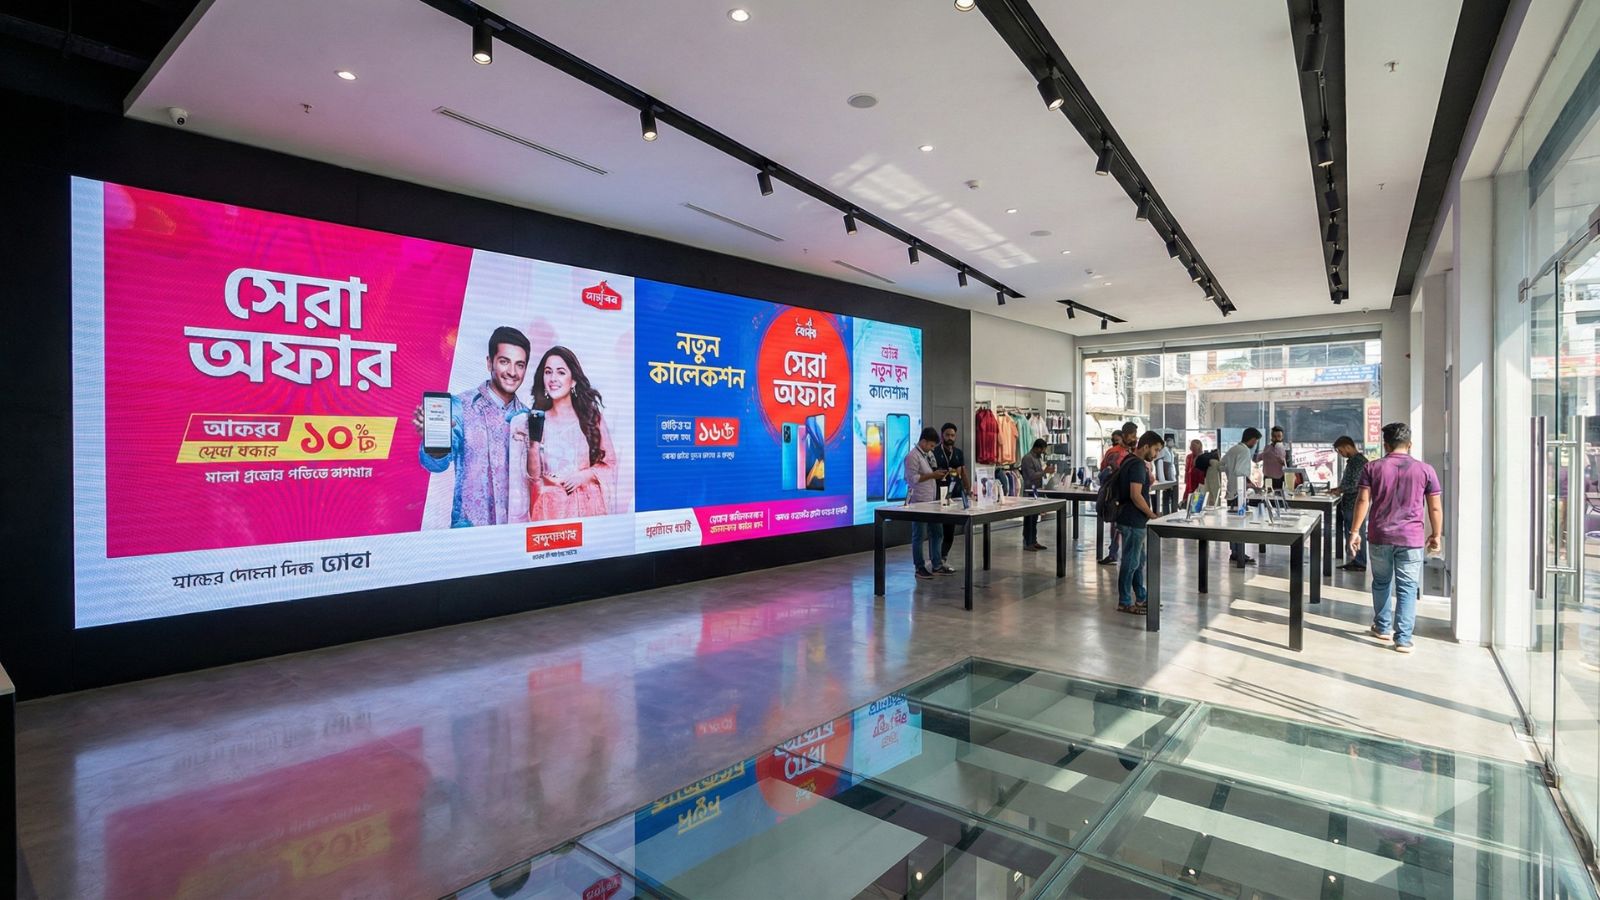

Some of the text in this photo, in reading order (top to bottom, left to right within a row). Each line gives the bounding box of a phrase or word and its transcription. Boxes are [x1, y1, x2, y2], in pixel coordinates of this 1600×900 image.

[224, 267, 368, 330] সেরা
[183, 325, 397, 391] অফার
[676, 332, 721, 363] নতুন
[648, 360, 746, 389] কালেকশন
[784, 350, 827, 379] সেরা
[871, 362, 892, 382] নতুন
[773, 379, 837, 409] অফার
